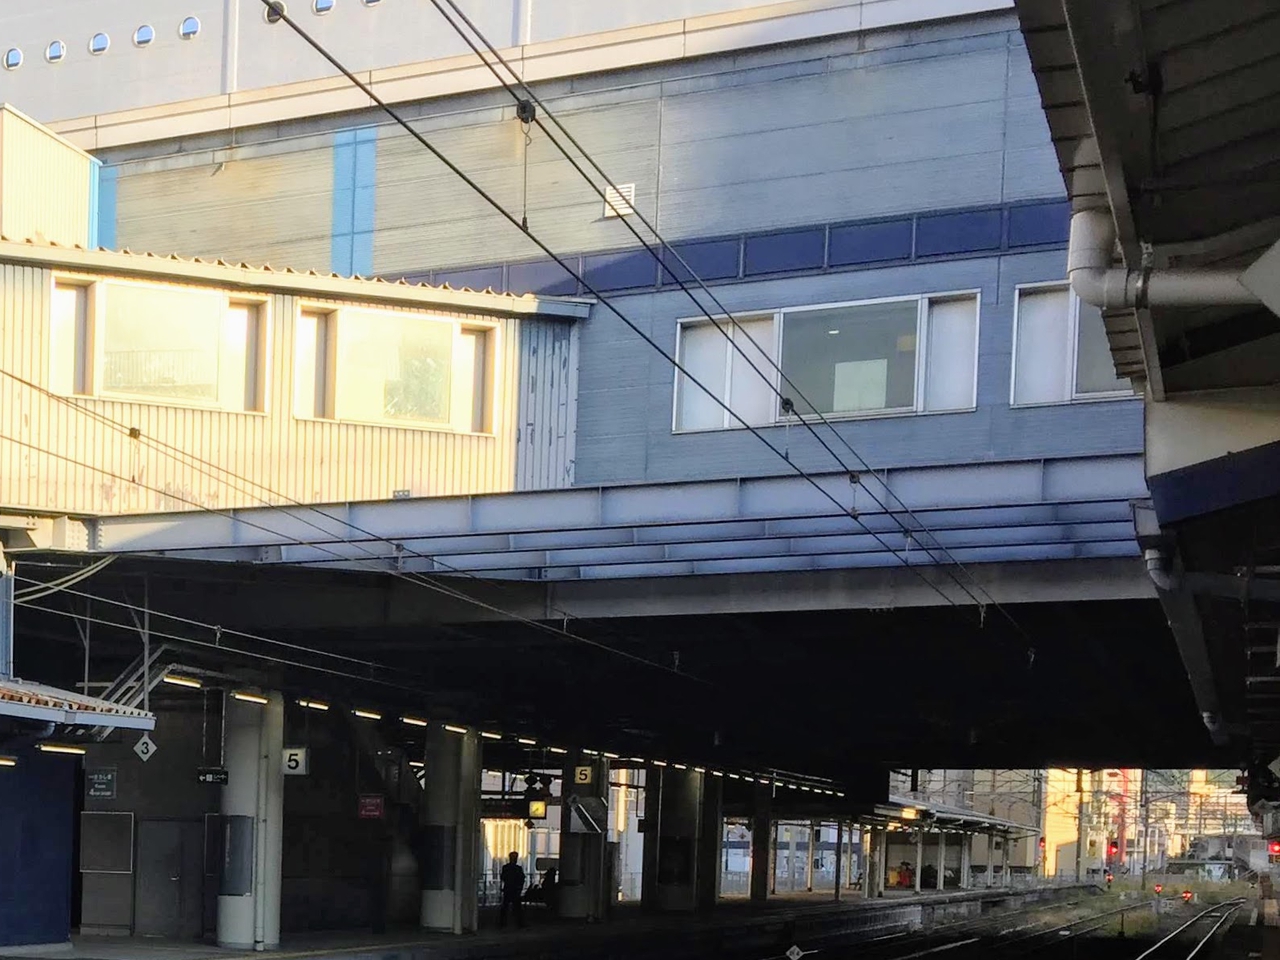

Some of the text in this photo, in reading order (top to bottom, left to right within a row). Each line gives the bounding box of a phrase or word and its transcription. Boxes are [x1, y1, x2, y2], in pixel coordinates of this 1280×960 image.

[141, 741, 150, 755] 3
[287, 753, 299, 770] 5
[578, 769, 588, 781] 5
